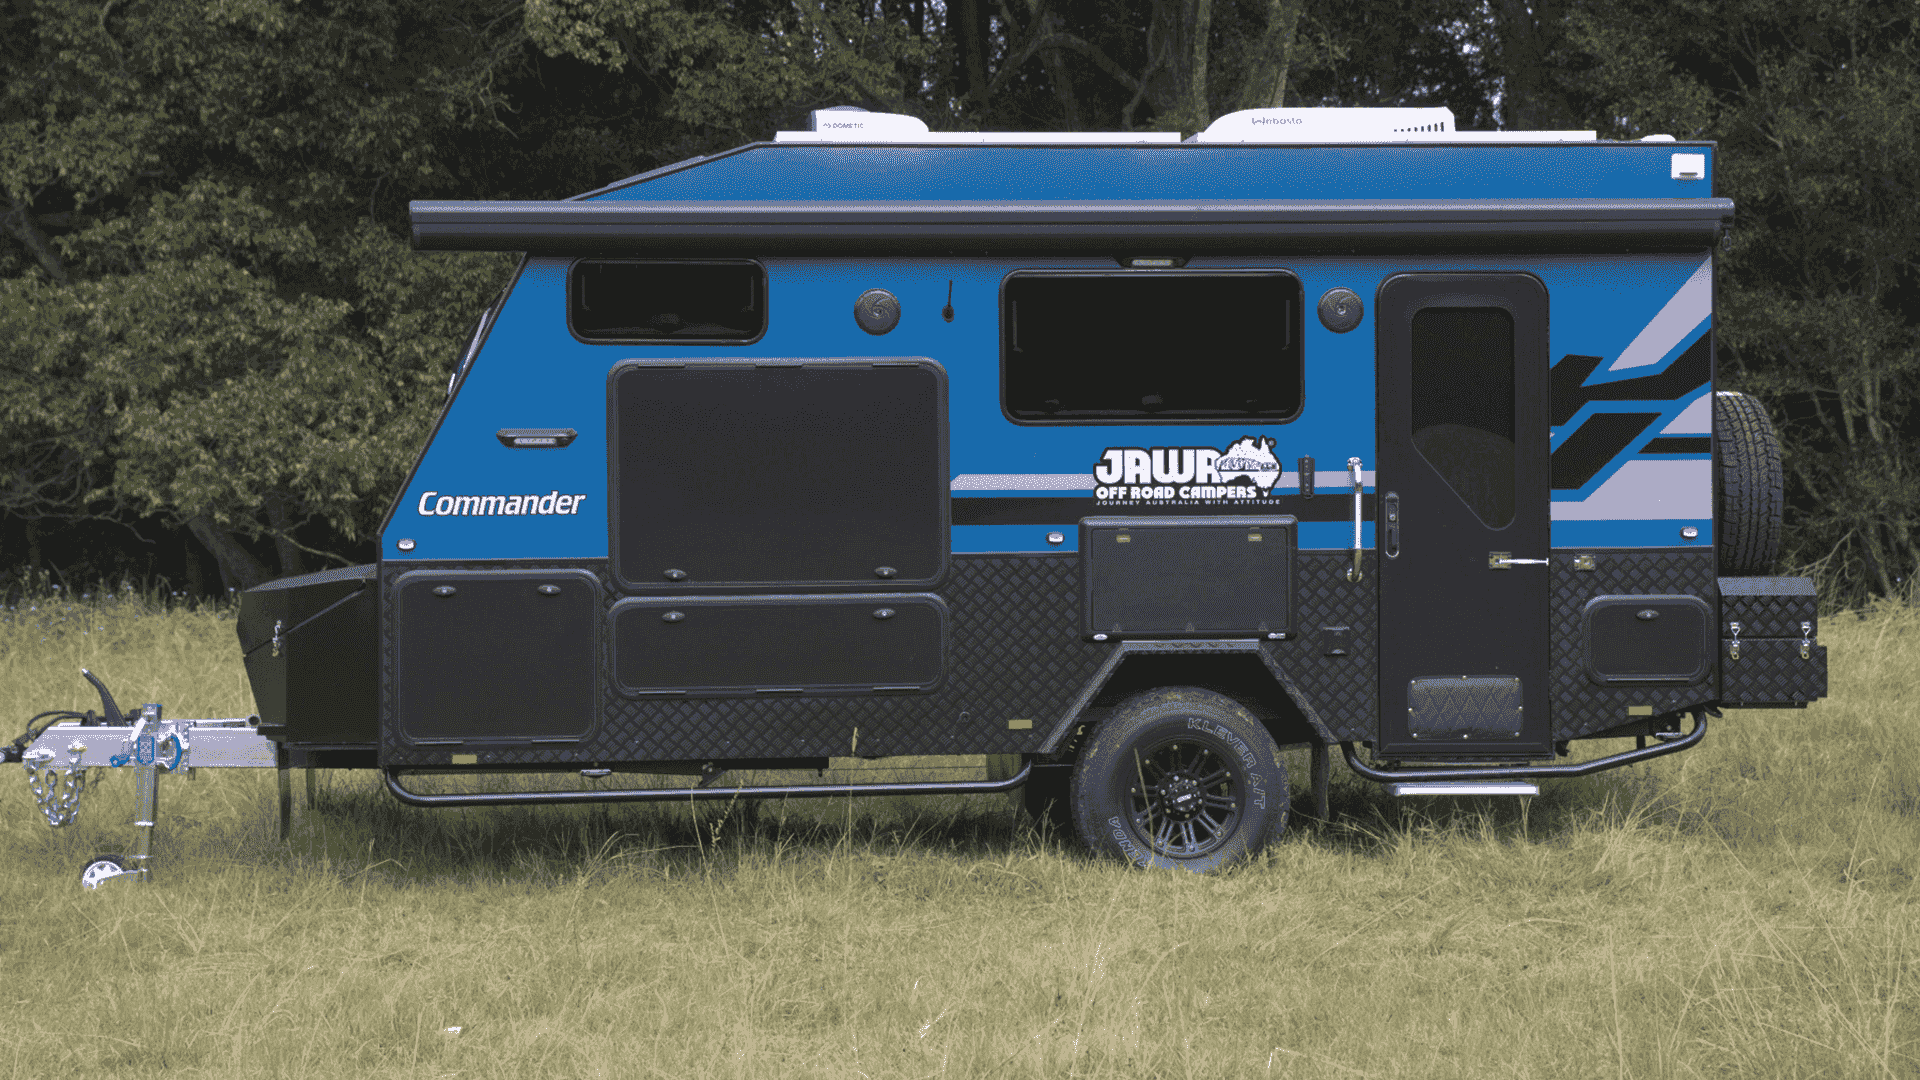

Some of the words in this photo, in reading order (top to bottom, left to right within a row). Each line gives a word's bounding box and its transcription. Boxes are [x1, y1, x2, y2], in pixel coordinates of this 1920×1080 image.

[417, 489, 588, 517] Commander
[1095, 485, 1127, 500] OFF
[1130, 485, 1176, 500] ROAD
[1178, 485, 1257, 500] CAMPERS
[1187, 717, 1257, 769] KLEVER
